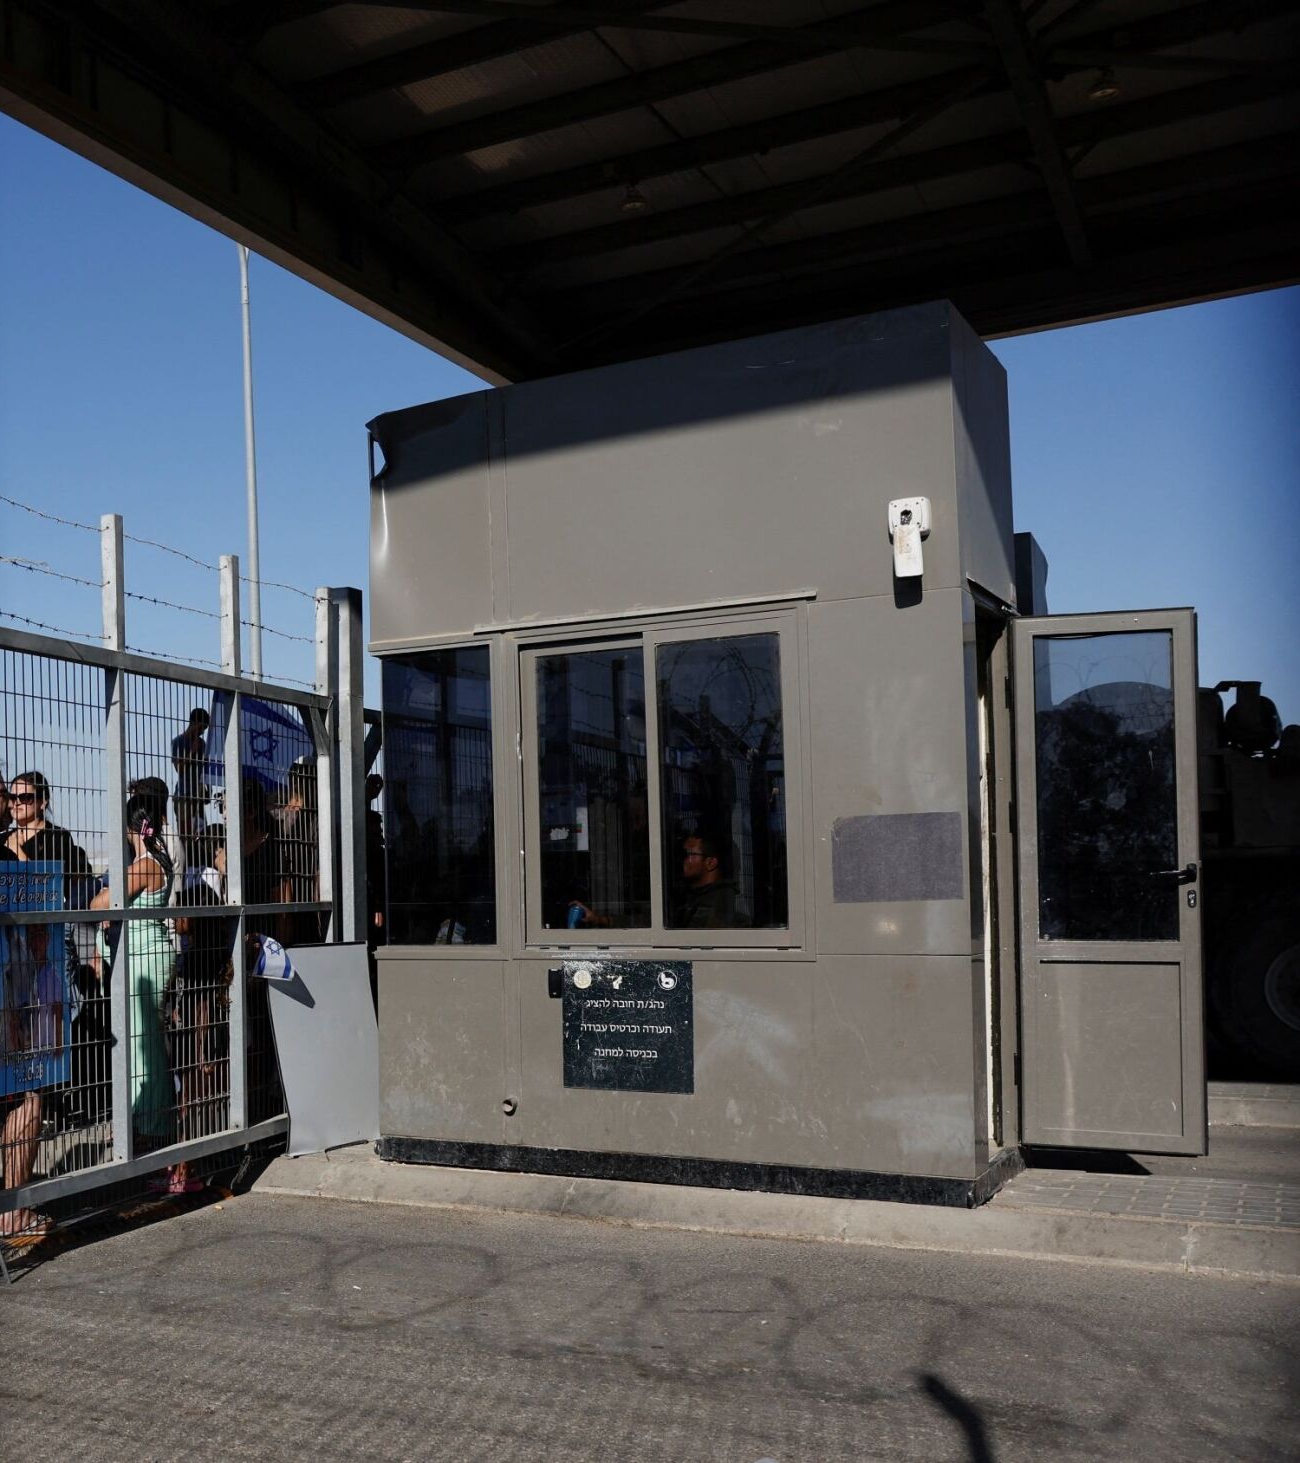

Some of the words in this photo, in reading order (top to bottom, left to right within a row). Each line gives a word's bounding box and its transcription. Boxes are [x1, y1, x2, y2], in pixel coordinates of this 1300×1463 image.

[586, 998, 611, 1008] להציג
[612, 1000, 635, 1008] חובה
[580, 1023, 608, 1032] עבודה
[609, 1024, 641, 1033] וכרטיס
[642, 1025, 672, 1034] תעודה
[594, 1047, 624, 1057] למחנה
[626, 1049, 658, 1059] בכניסה
